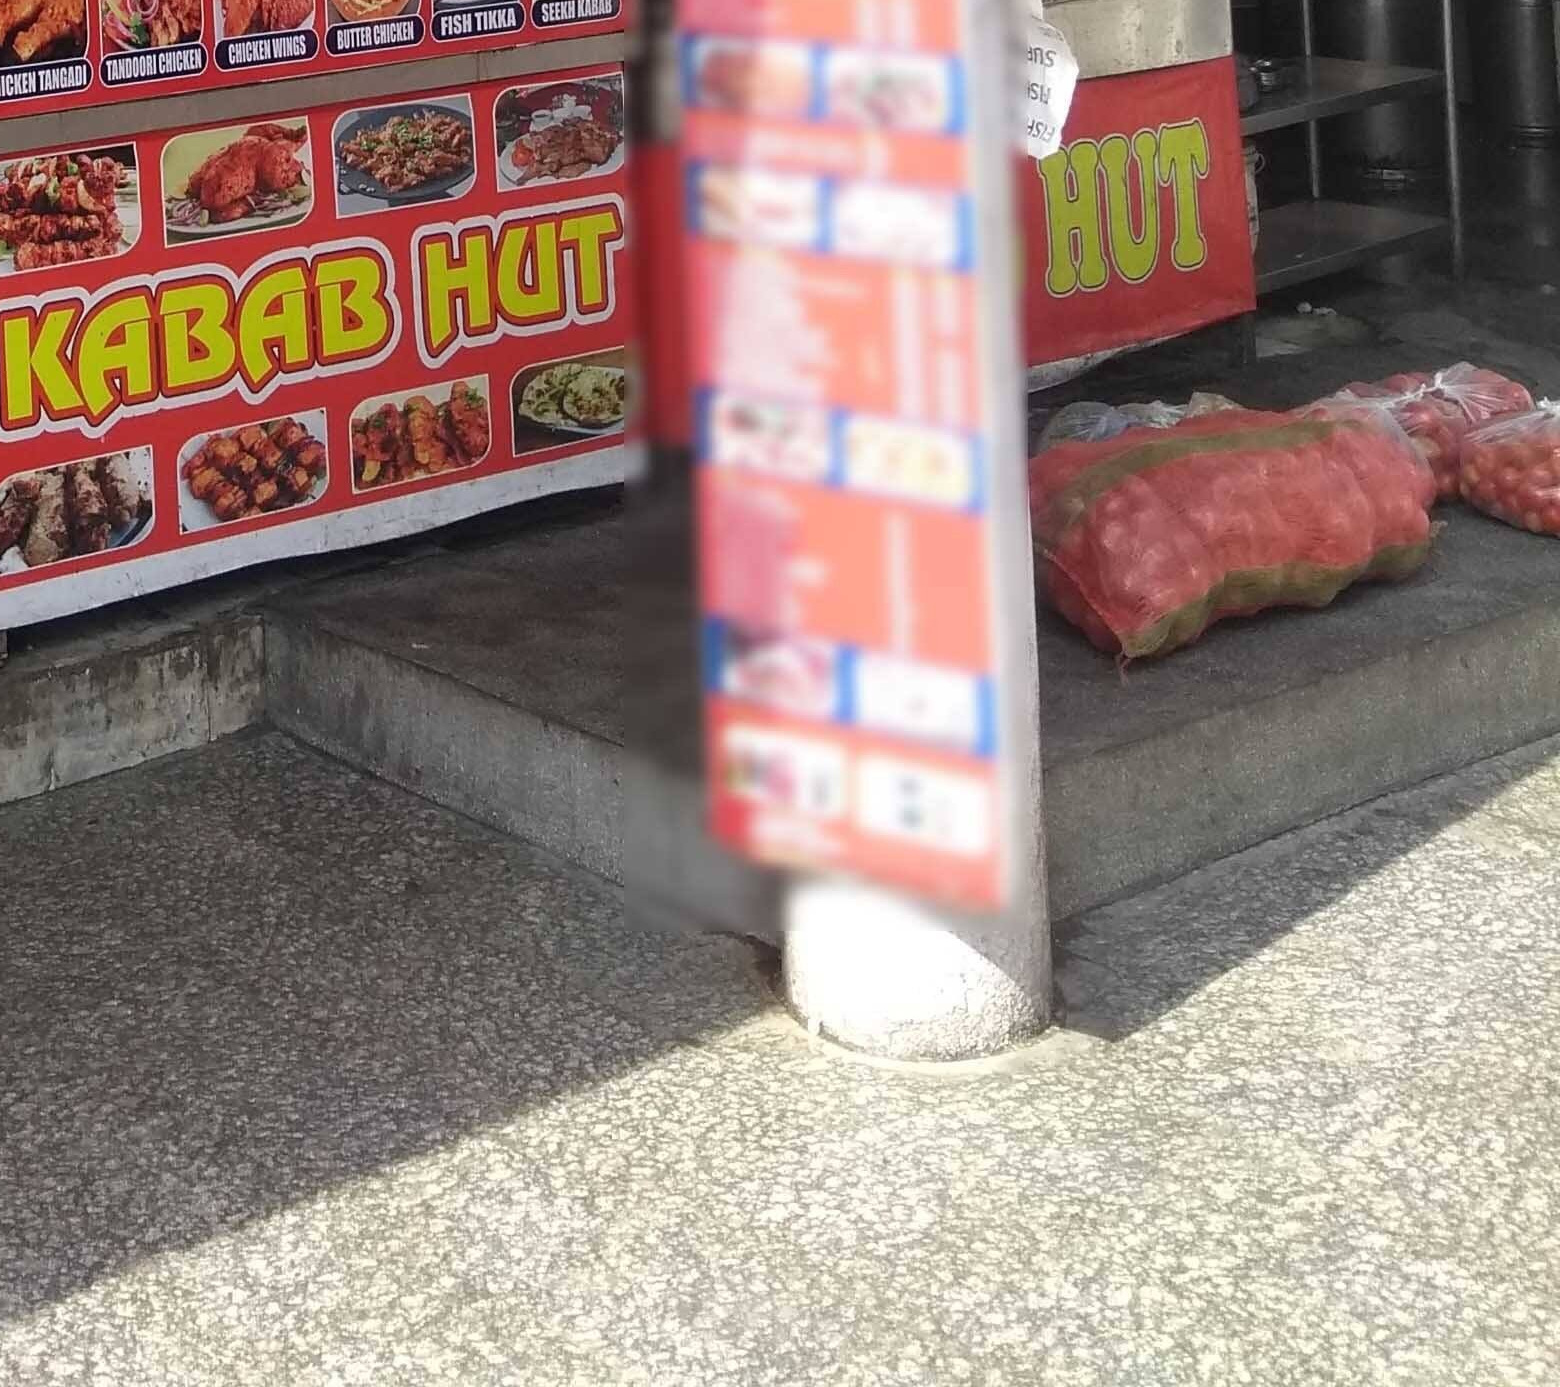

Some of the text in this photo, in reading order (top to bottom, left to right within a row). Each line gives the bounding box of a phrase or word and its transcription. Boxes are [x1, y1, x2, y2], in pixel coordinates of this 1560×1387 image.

[440, 7, 517, 36] FISH TIKKA
[541, 0, 576, 23] SEEKH
[337, 20, 415, 50] BUTTER CHICKEN
[105, 48, 203, 81] TANDOORI CHICKEN
[228, 36, 307, 65] CHICKEN WINGS
[38, 64, 87, 90] TANGADI
[1027, 81, 1052, 105] FIS
[1040, 117, 1209, 298] HUT
[419, 207, 622, 361] HUT
